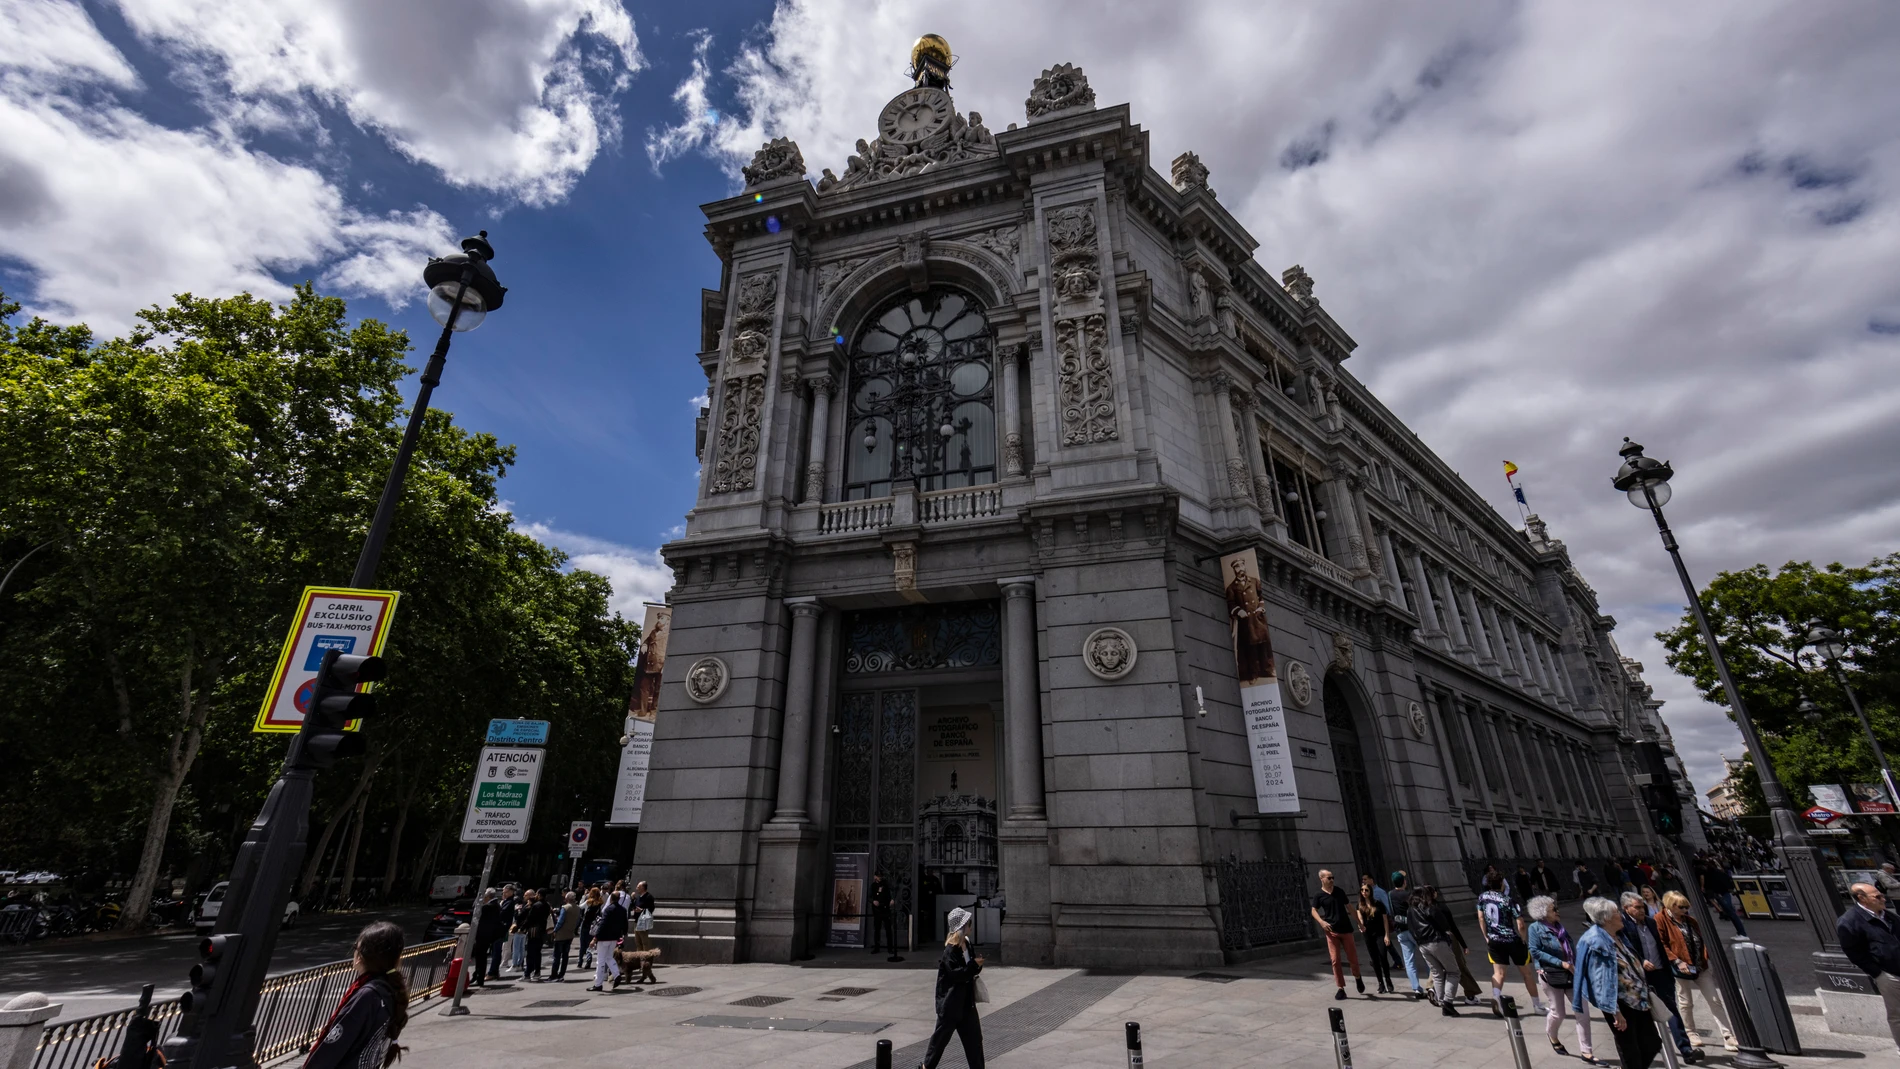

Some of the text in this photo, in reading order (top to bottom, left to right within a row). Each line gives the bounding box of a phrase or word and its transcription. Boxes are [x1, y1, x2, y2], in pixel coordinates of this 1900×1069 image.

[328, 604, 364, 612] CARRIL
[314, 612, 372, 621] EXCLUSIVO
[306, 622, 372, 631] BUS-TAXI-MOTOS
[1246, 706, 1280, 715] FOTOGRÁFICO
[928, 722, 978, 732] FOTOGRÁFICO
[945, 738, 973, 746] ESPAÑA
[486, 752, 537, 762] ATENCIÓN
